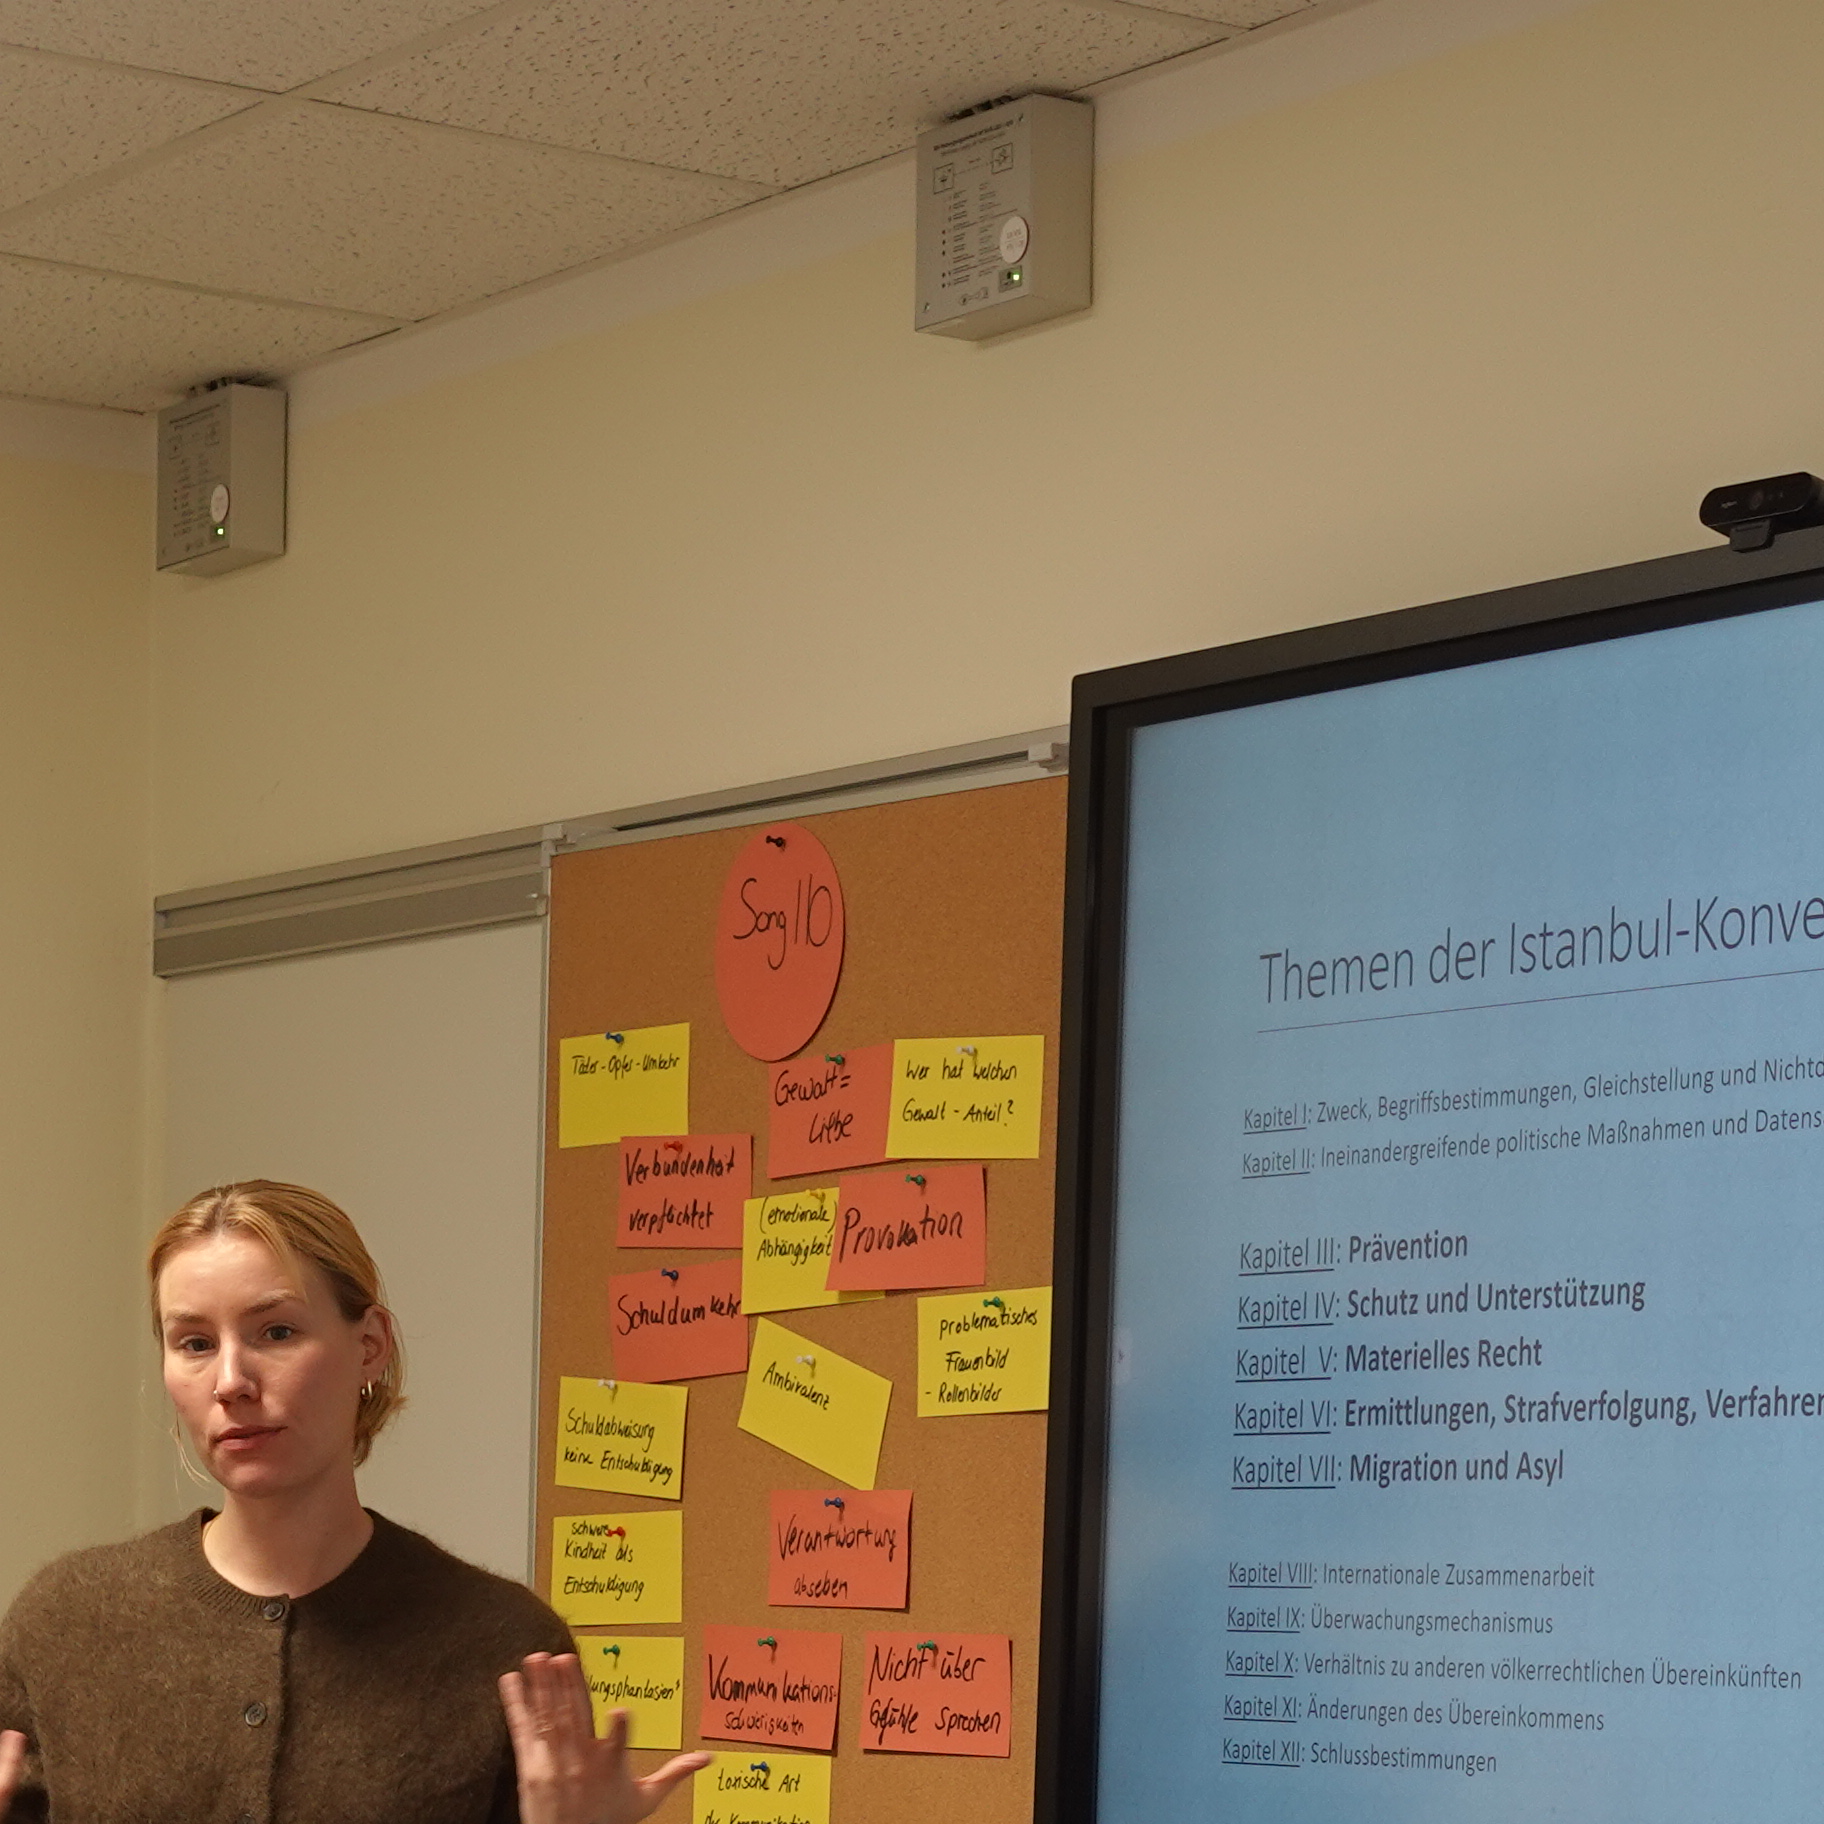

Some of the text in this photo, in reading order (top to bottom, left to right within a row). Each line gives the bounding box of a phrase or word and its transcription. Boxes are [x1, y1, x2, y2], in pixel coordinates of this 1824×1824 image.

[733, 873, 833, 970] Song 110
[1259, 947, 1414, 1004] Themen
[1429, 928, 1495, 985] der
[942, 1058, 963, 1079] hat
[1243, 1106, 1301, 1133] Kapitel
[1317, 1098, 1371, 1124] Zweck,
[1378, 1079, 1577, 1120] Begriffsbestimmungen,
[1583, 1066, 1713, 1100] Gleichstellung
[1721, 1061, 1756, 1086] und
[626, 1145, 734, 1185] Verbundenheit
[1242, 1149, 1295, 1176] Kapitel
[1321, 1133, 1489, 1168] Ineinandergreifende
[1495, 1123, 1581, 1156] politische
[1587, 1118, 1705, 1148] Maßnahmen
[1712, 1111, 1747, 1137] und
[840, 1205, 962, 1263] Provokation
[1239, 1229, 1468, 1273] Kapitel III: Prävention
[1237, 1277, 1646, 1326] Kapitel IV: Schutz und Unterstützung
[1236, 1336, 1542, 1379] Kapitel V: Materielles Recht
[762, 1361, 829, 1411] Ambivalenz
[1234, 1400, 1306, 1433] Kapitel
[1310, 1400, 1338, 1427] VI:
[1345, 1392, 1496, 1432] Ermittlungen,
[1504, 1389, 1697, 1426] Strafverfolgung,
[1232, 1449, 1564, 1488] Kapitel VII: Migration und Asyl
[564, 1539, 607, 1560] Kindheit
[778, 1514, 897, 1563] Verantwortung
[1228, 1560, 1594, 1588] Kapitel VIII: Internationale Zusammenarbeit
[1226, 1605, 1553, 1636] Kapitel IX: Überwachungsmechanismus
[868, 1645, 986, 1695] Nicht über
[1225, 1650, 1801, 1689] Kapitel X: Verhältnis zu anderen völkerrechtlichen Übereinkünften
[1224, 1693, 1604, 1731] Kapitel XI: Änderungen des Übereinkommens
[1222, 1739, 1497, 1776] Kapitel XII: Schlussbestimmungen
[779, 1774, 801, 1792] Art
